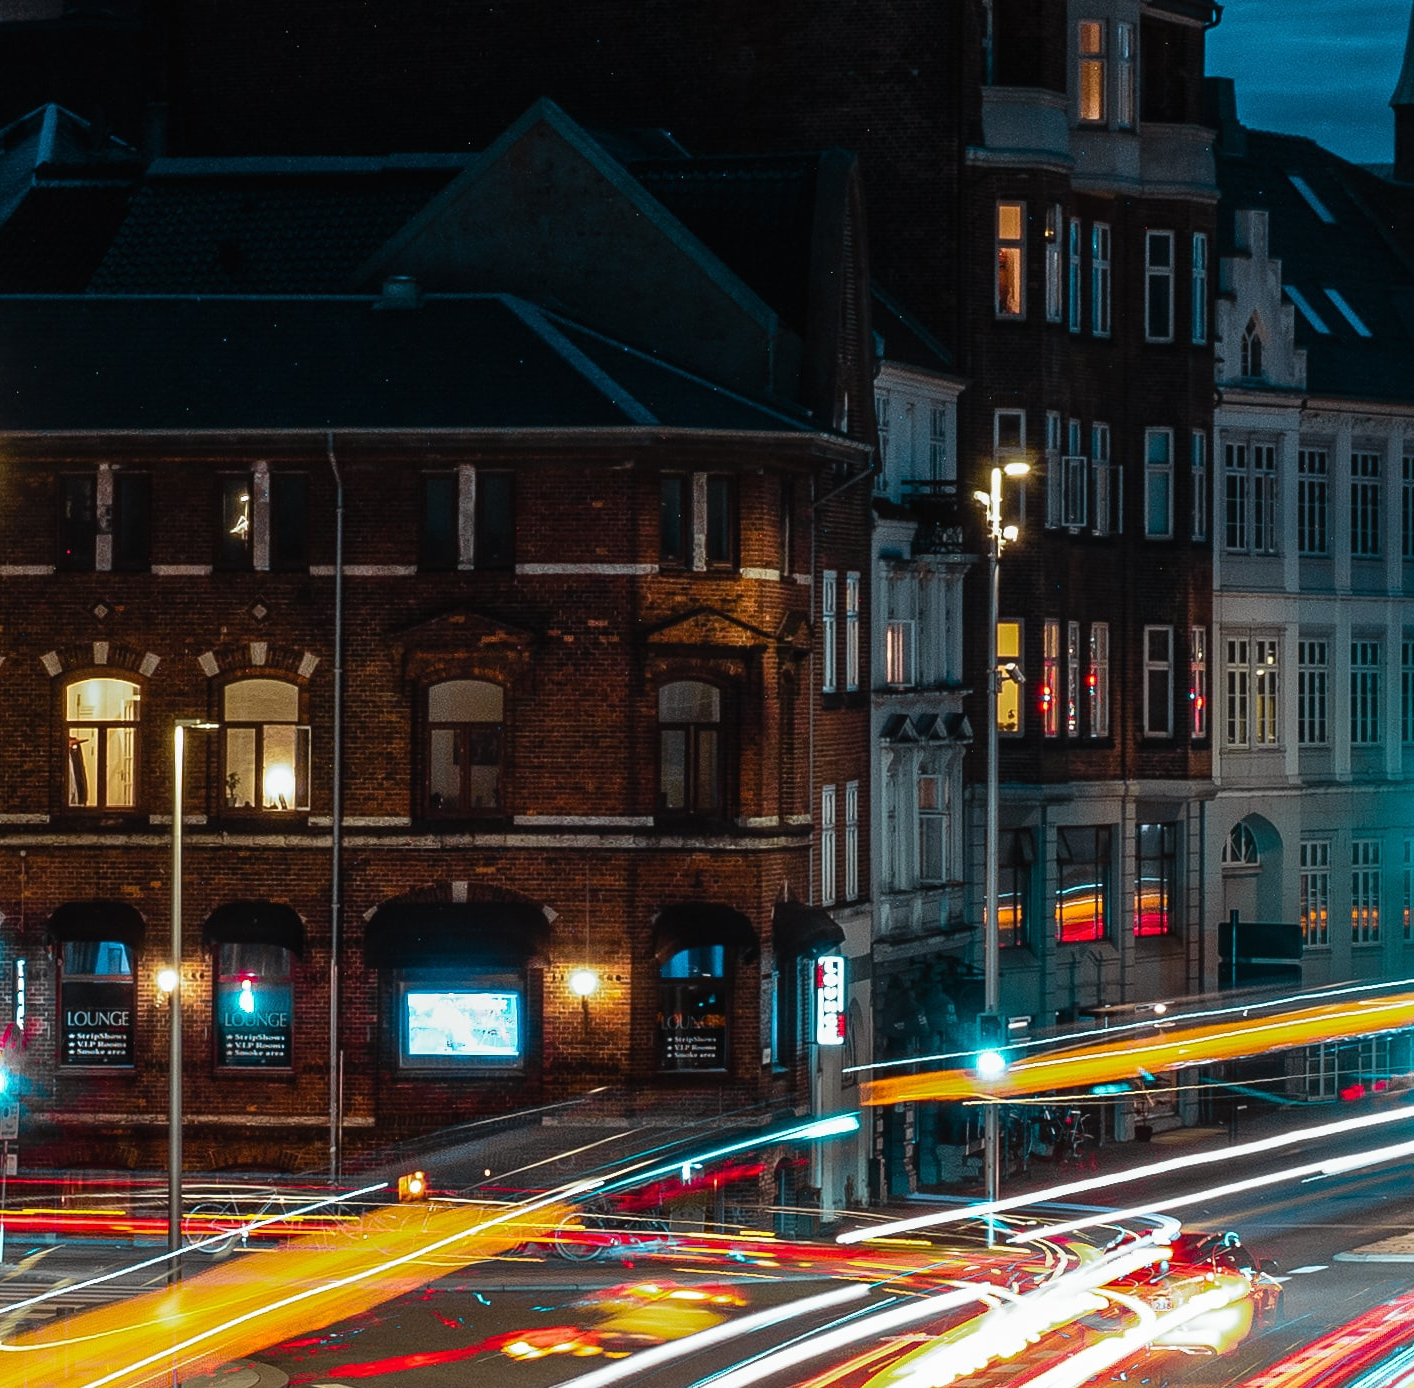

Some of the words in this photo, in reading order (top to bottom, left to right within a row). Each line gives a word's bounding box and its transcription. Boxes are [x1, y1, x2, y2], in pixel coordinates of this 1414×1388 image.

[67, 1011, 129, 1026] LOUNGE
[225, 1012, 287, 1027] LOUNGE
[77, 1032, 127, 1041] StripShows
[234, 1033, 285, 1042] StripShows
